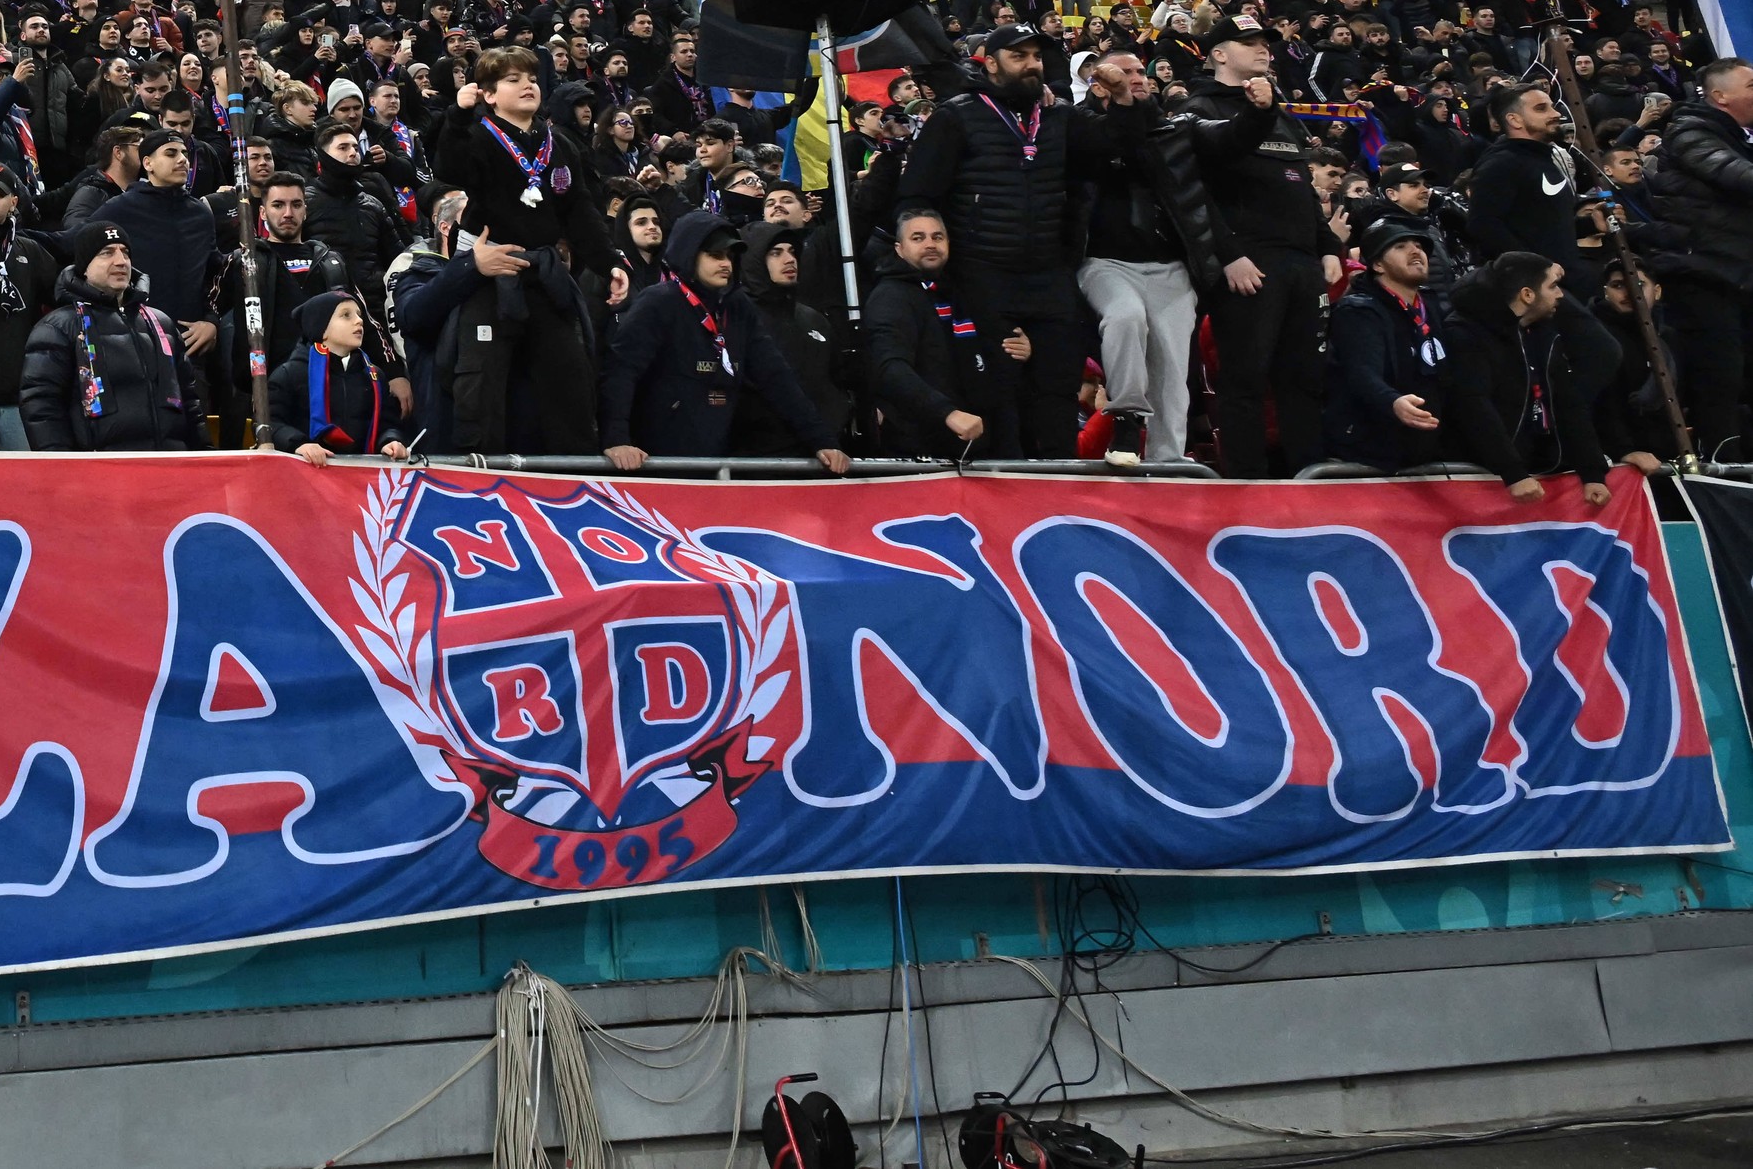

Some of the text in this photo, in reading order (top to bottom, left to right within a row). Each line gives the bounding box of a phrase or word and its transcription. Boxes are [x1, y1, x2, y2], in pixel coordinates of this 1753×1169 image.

[434, 519, 649, 579] N O
[482, 641, 713, 741] R D
[689, 512, 1682, 824] NORD
[533, 817, 696, 886] 1995
